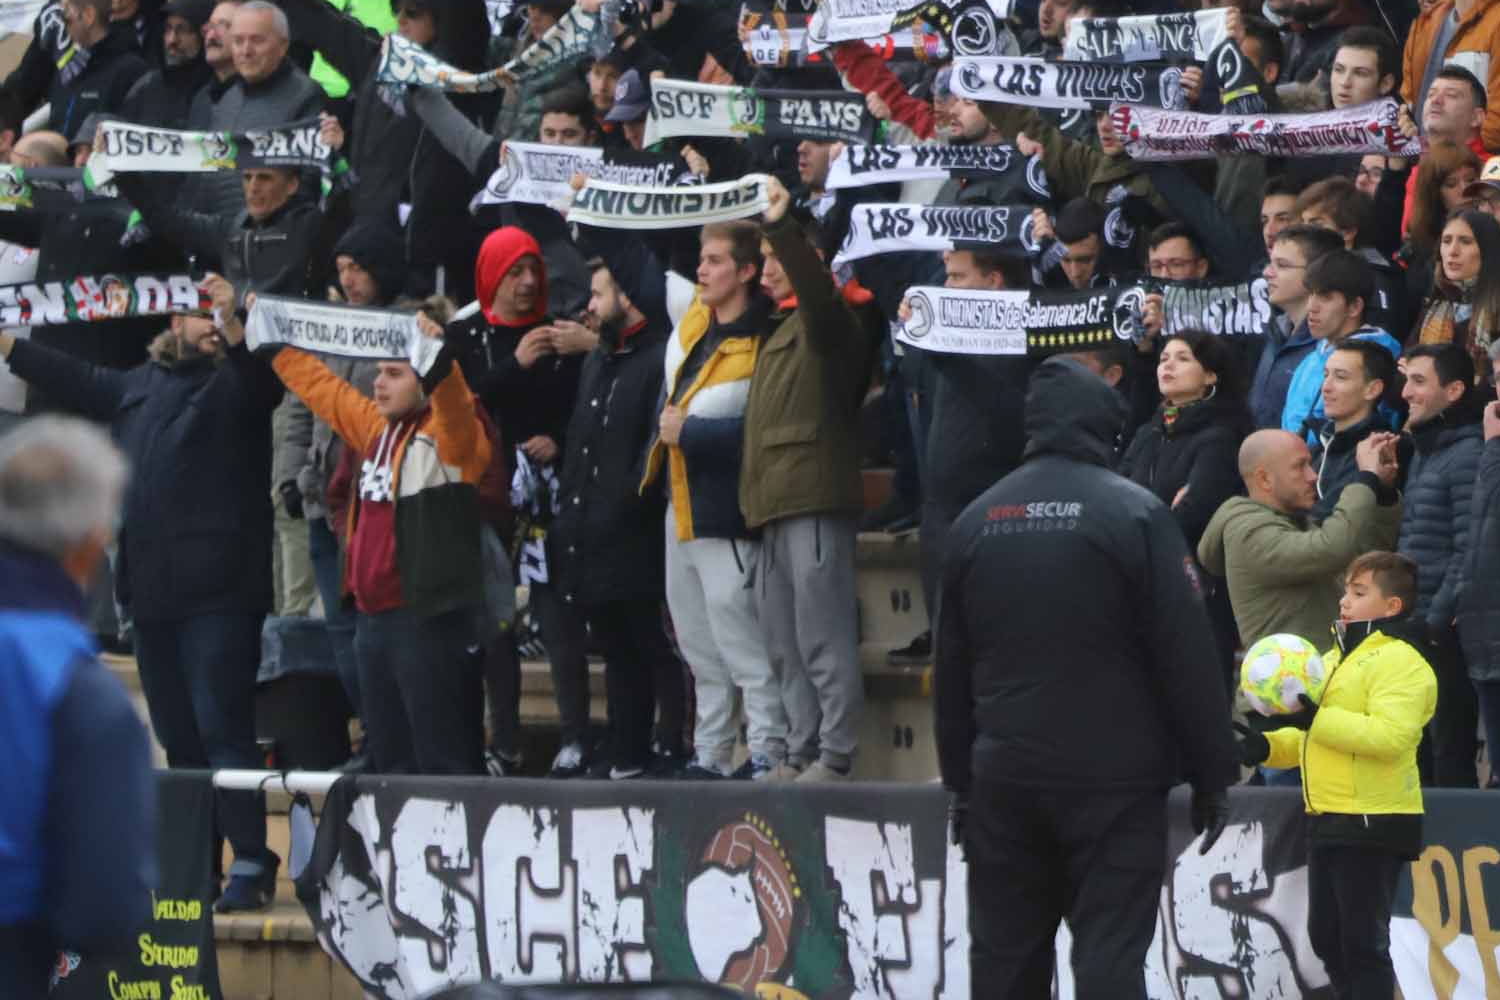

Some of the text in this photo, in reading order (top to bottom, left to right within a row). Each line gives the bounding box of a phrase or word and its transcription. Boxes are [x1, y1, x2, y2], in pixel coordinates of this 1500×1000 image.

[994, 63, 1146, 102] LAS VILLAS
[778, 99, 864, 131] FANS
[247, 127, 331, 159] FANS
[848, 146, 902, 175] LAS
[866, 207, 1008, 242] LAS VILLAS
[940, 296, 1108, 329] UNIONISTAS de Salamanca C.F.
